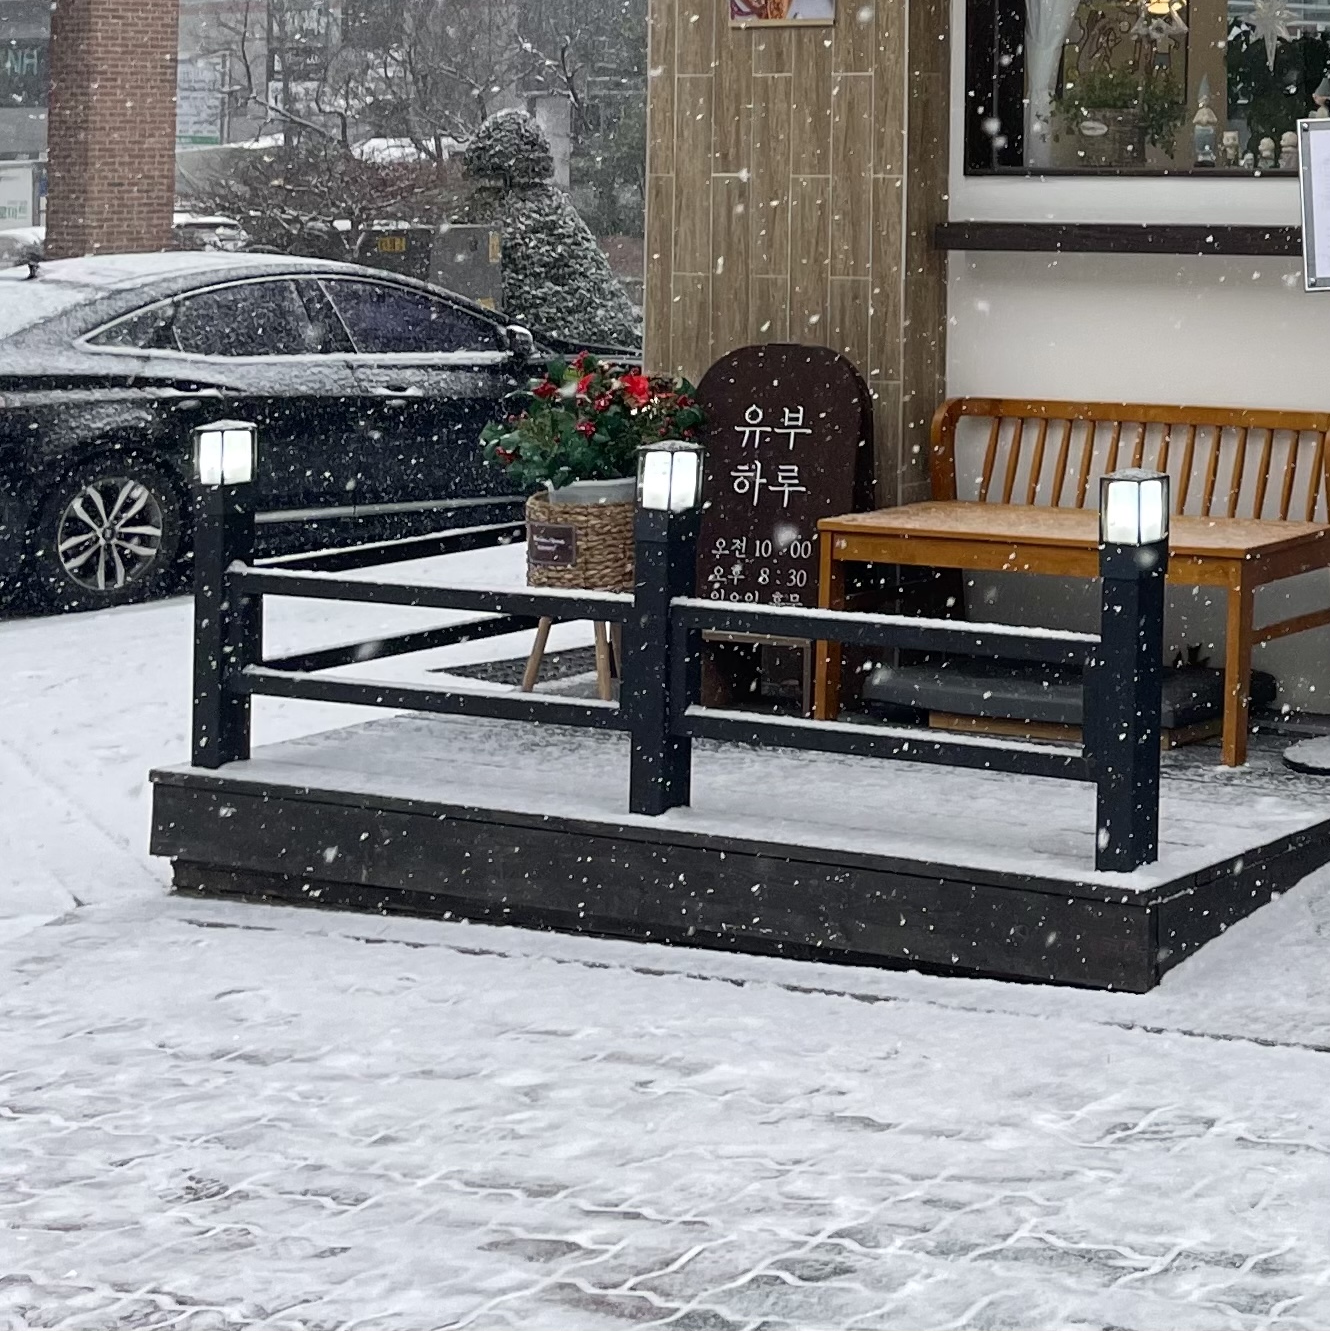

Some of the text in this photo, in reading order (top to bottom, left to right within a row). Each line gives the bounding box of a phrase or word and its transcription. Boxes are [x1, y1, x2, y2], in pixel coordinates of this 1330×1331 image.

[735, 404, 812, 451] 유부
[730, 460, 806, 508] 하루
[712, 536, 746, 558] 오전
[709, 565, 745, 585] 오후
